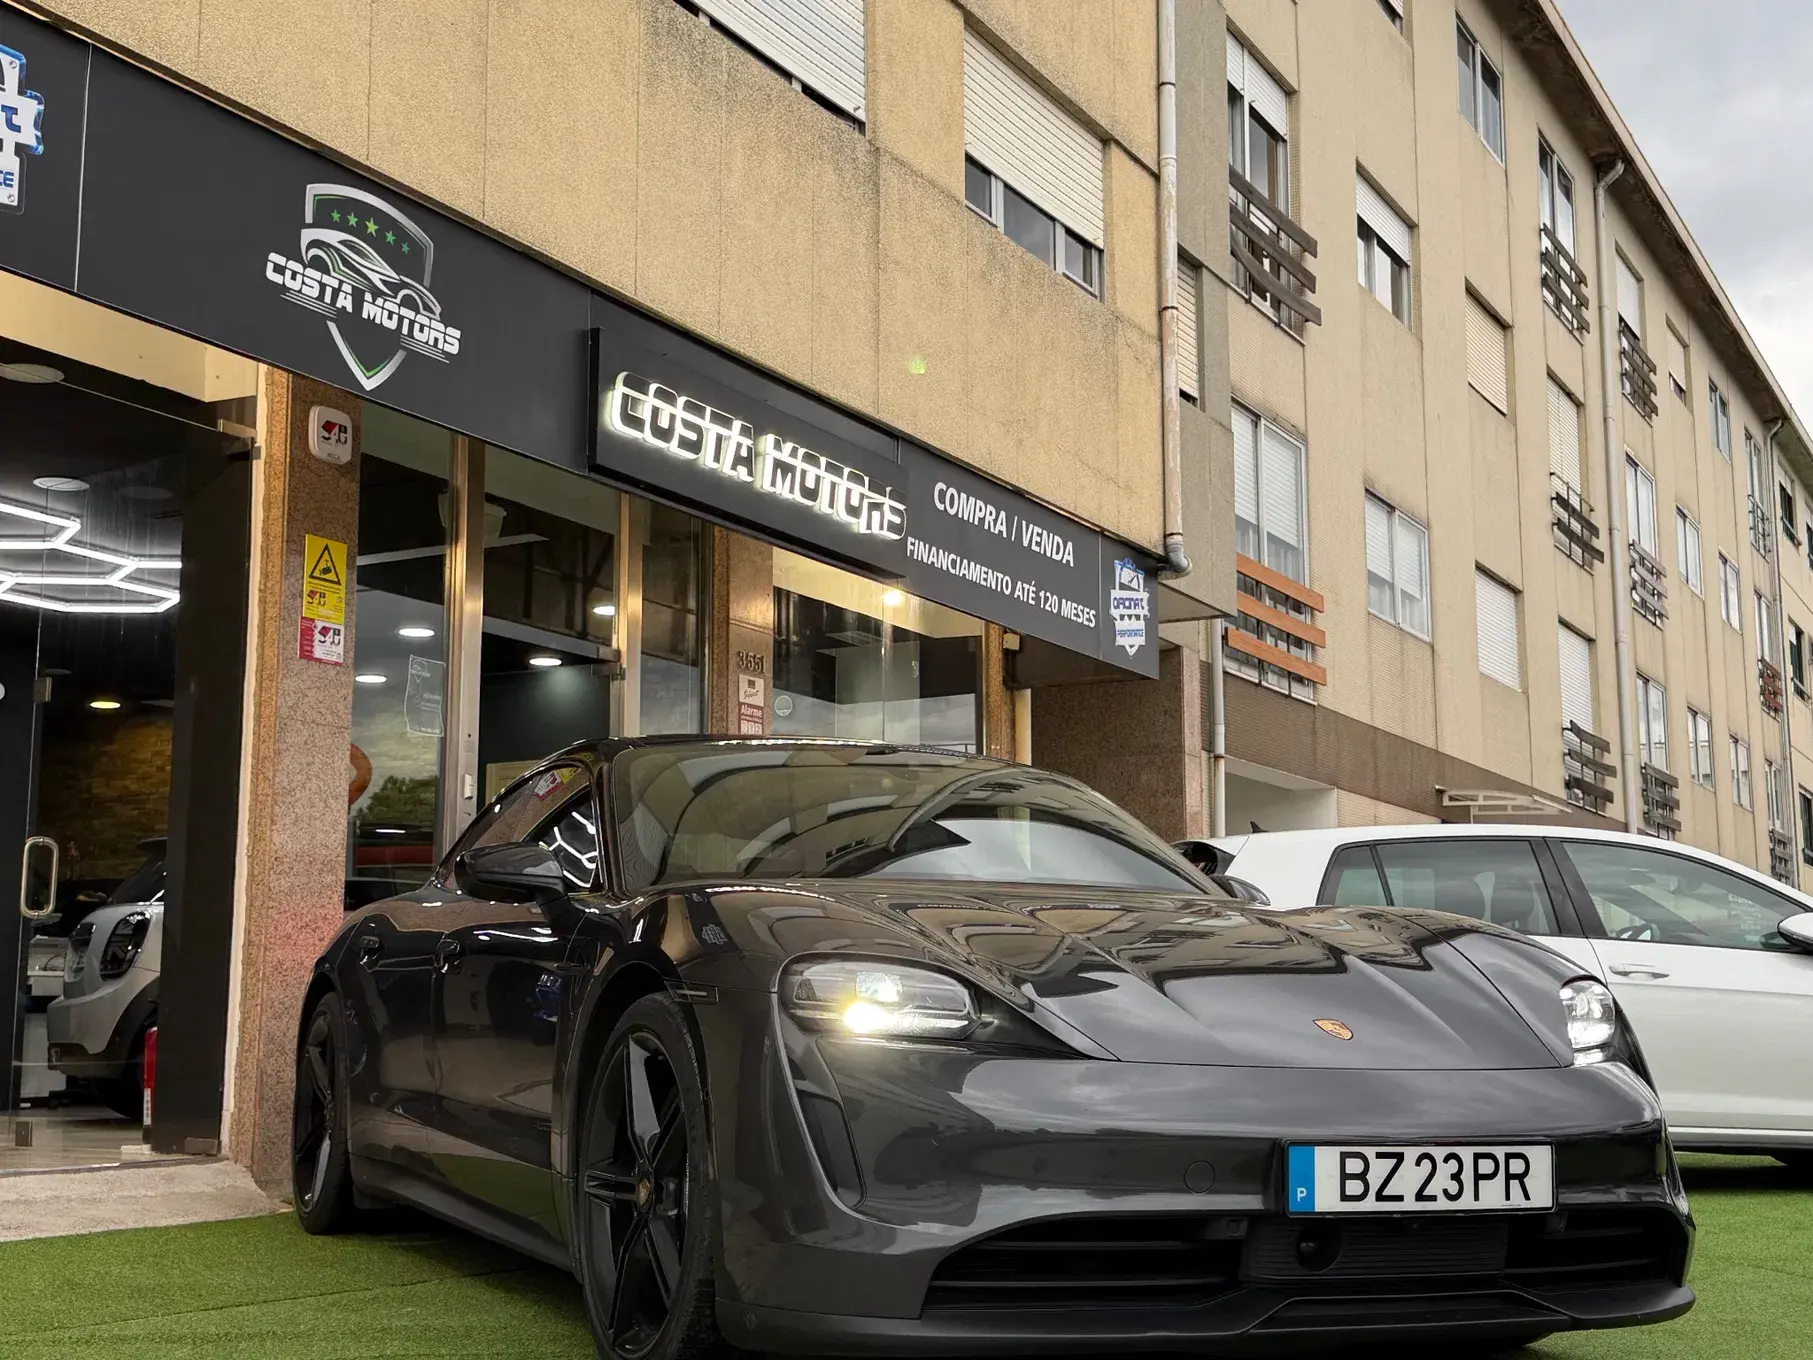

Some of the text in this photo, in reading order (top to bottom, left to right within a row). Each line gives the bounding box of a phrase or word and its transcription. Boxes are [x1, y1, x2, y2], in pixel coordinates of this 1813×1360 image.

[265, 252, 462, 355] COSTA MOTORS
[610, 371, 907, 541] COSTA MOTORS
[933, 481, 1007, 539] COMPRA
[1021, 519, 1075, 568] VENDA
[906, 536, 1097, 629] FINANCIAMENTO ATÉ 120 MESES
[740, 704, 763, 718] Alarme
[1296, 1187, 1307, 1202] P
